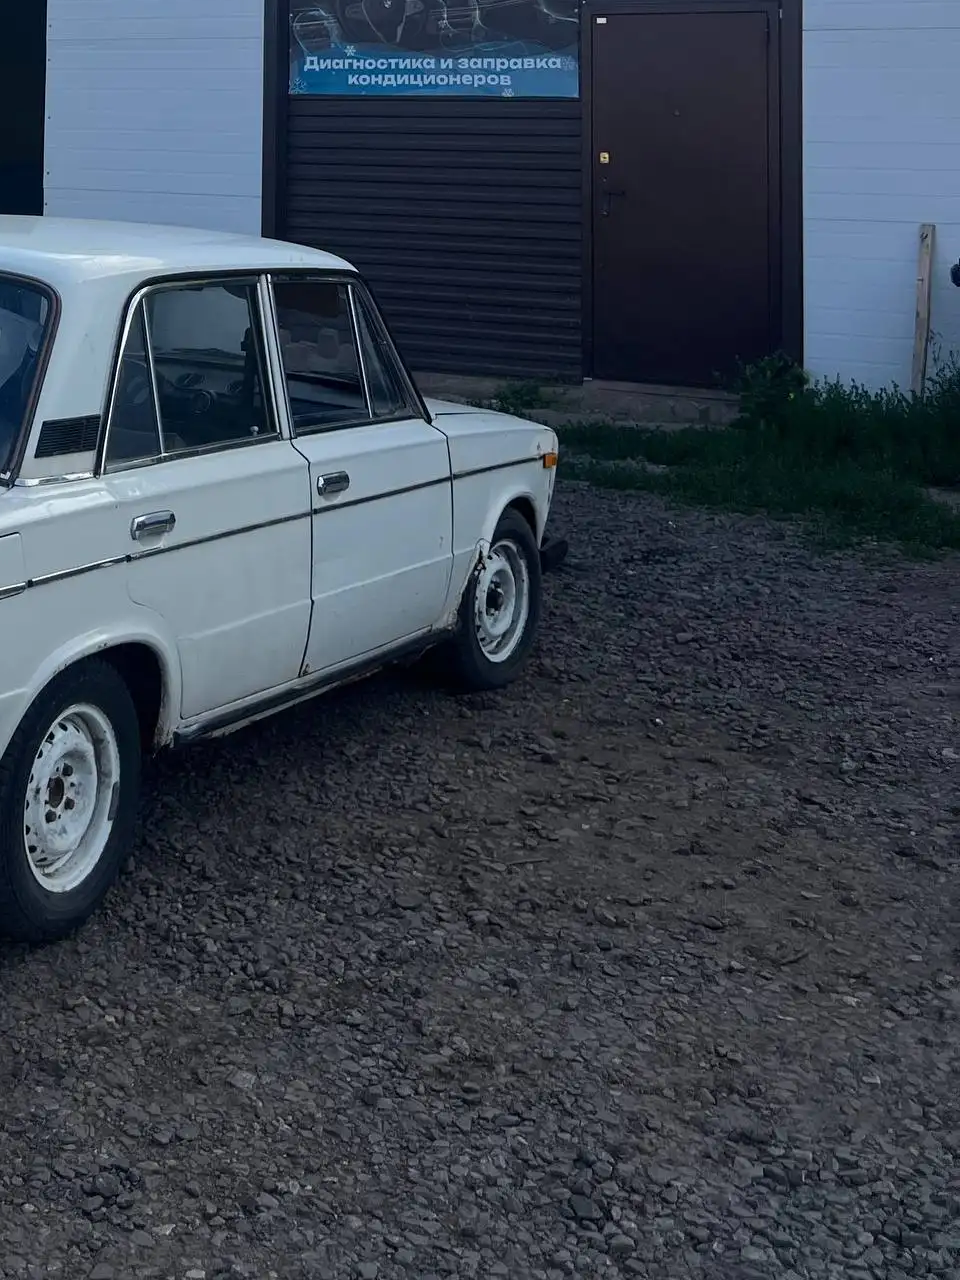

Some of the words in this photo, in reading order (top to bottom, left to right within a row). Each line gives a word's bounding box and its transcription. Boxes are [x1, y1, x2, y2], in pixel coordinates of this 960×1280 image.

[303, 56, 436, 72] Диагностика
[440, 59, 453, 70] и
[458, 58, 561, 72] заправка
[347, 74, 512, 88] кондиционеров
